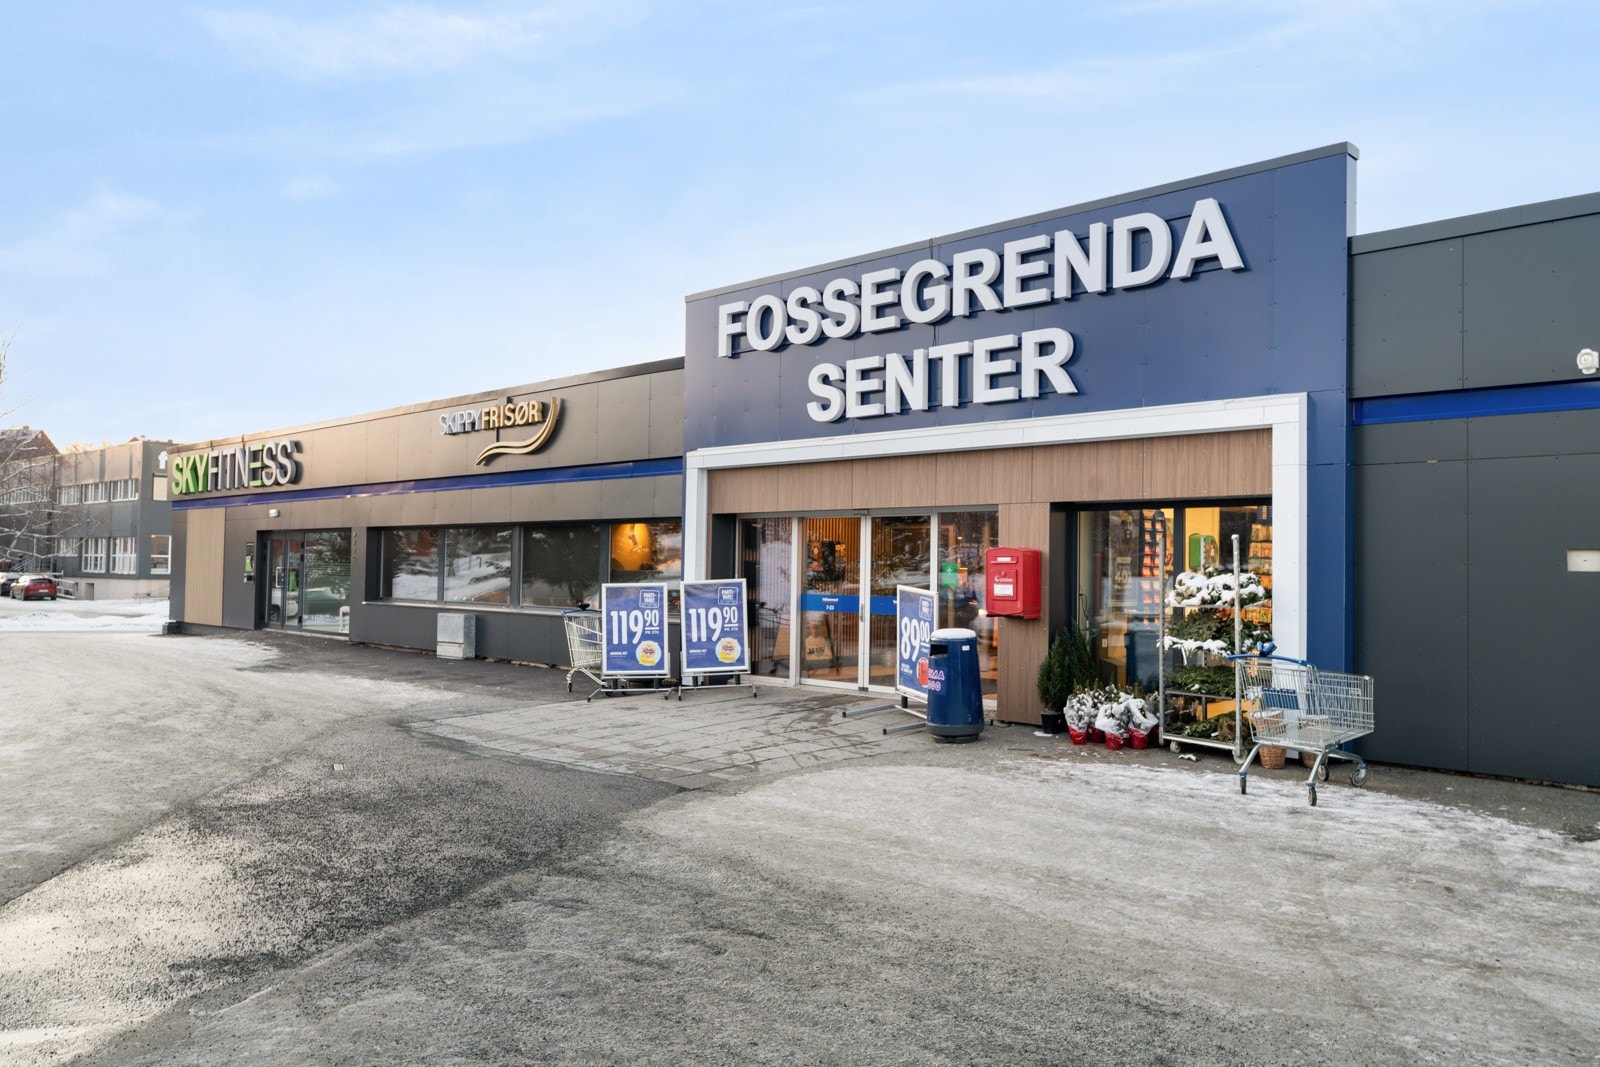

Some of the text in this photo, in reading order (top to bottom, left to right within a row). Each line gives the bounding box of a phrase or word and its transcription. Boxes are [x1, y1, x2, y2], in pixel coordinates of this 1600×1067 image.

[718, 198, 1244, 358] FOSSEGRENDA
[807, 327, 1078, 423] SENTER
[610, 609, 659, 644] 119 90
[688, 606, 738, 642] 119 90
[901, 616, 930, 662] 89 00
